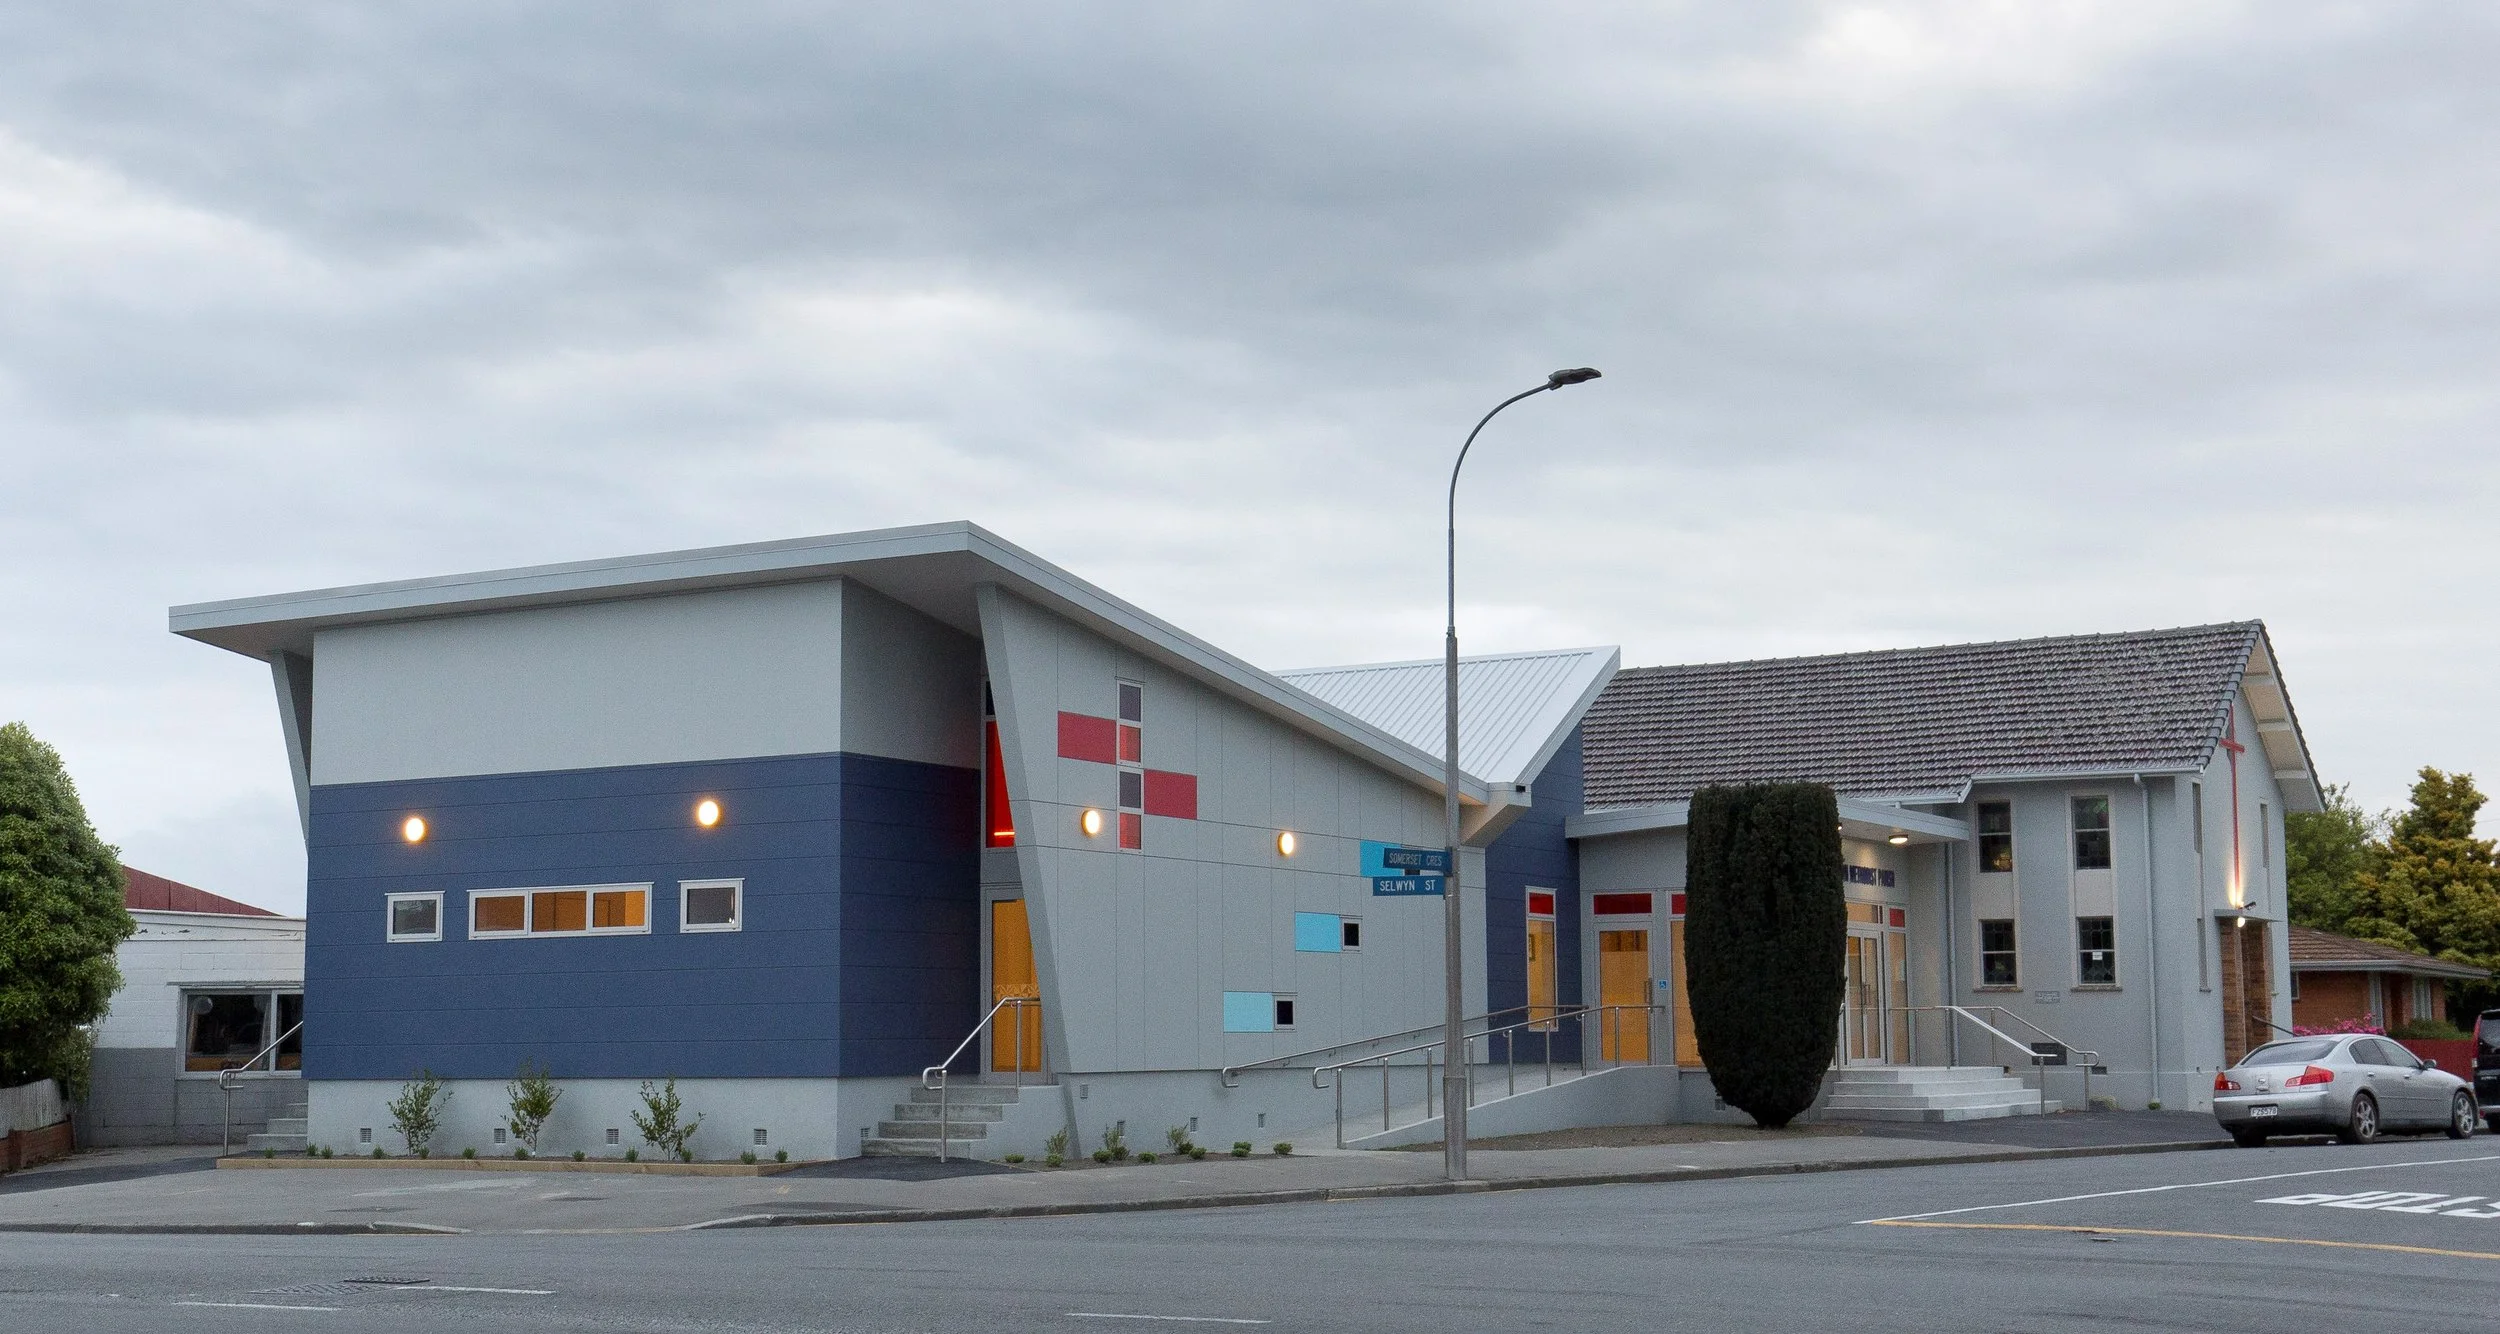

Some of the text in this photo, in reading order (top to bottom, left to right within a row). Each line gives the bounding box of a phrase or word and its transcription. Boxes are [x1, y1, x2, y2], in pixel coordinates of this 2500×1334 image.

[1389, 853, 1443, 867] SOMERSET CRES
[1379, 879, 1436, 891] SELWYN ST
